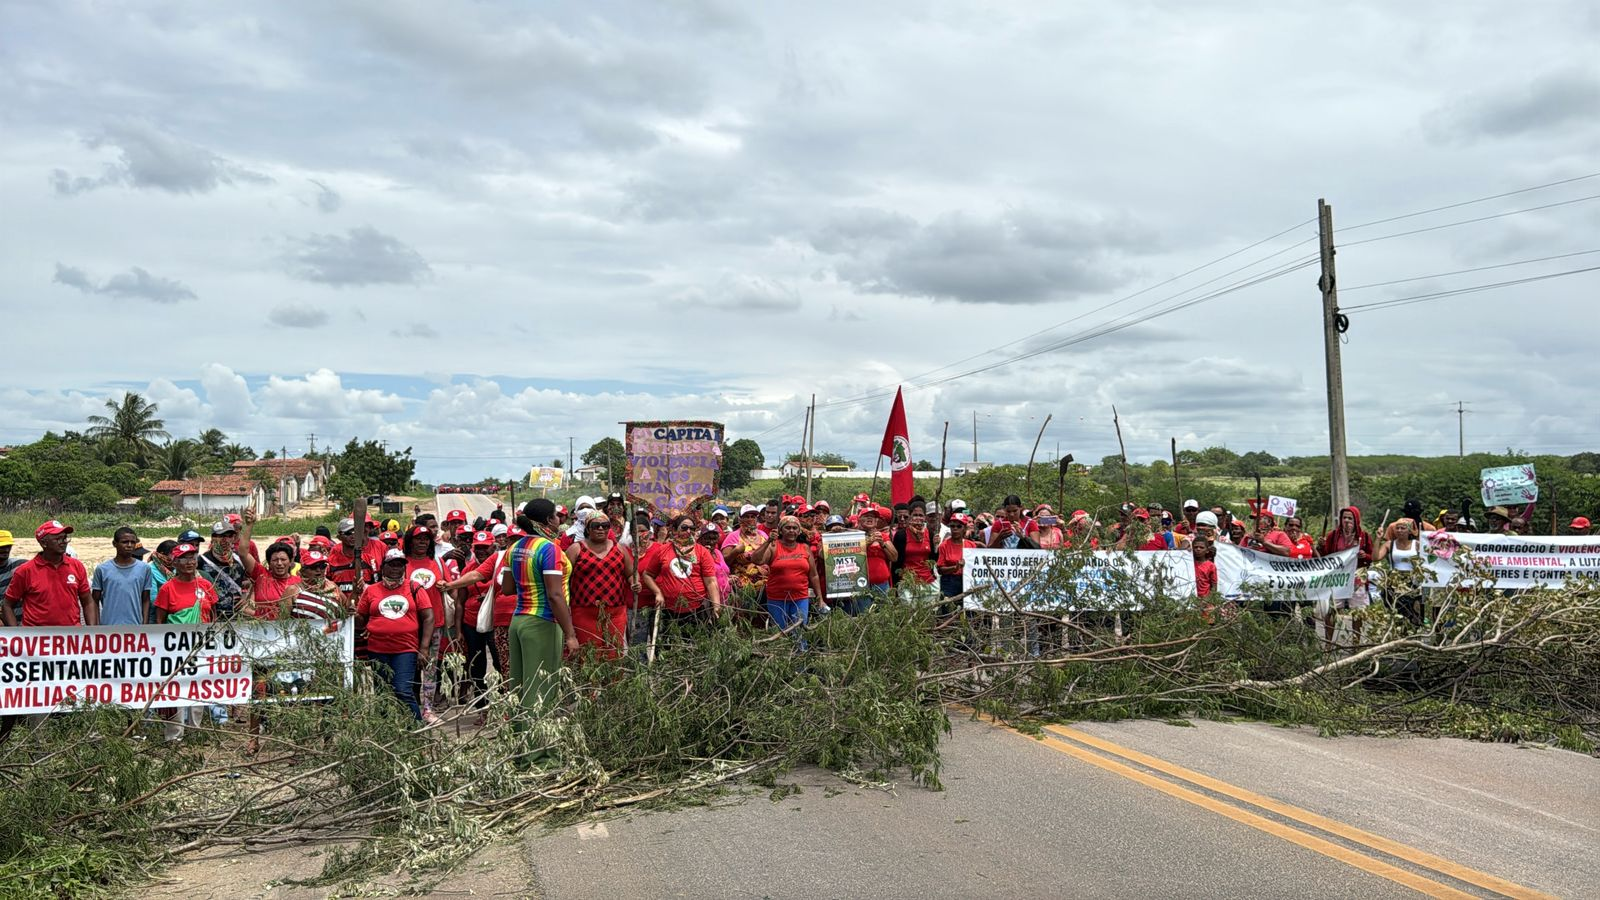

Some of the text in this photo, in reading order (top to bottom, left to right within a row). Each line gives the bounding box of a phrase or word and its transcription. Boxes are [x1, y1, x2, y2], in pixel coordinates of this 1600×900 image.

[640, 468, 651, 479] A
[1475, 543, 1546, 554] AGRONEGÓCIO
[1549, 543, 1556, 554] É
[836, 557, 854, 565] MST
[974, 556, 980, 566] A
[1011, 555, 1021, 566] SÓ
[1507, 556, 1566, 567] AMBIENTAL,
[1569, 557, 1576, 566] A
[1523, 568, 1530, 579] É
[1308, 576, 1321, 589] EU
[1321, 573, 1350, 588] POSSO?
[0, 633, 156, 657] GOVERNADORA,
[223, 629, 236, 650] O
[160, 655, 198, 677] DAS
[206, 654, 242, 675] 100
[0, 677, 250, 708] MÍLIAS DO BAIXO ASSU?
